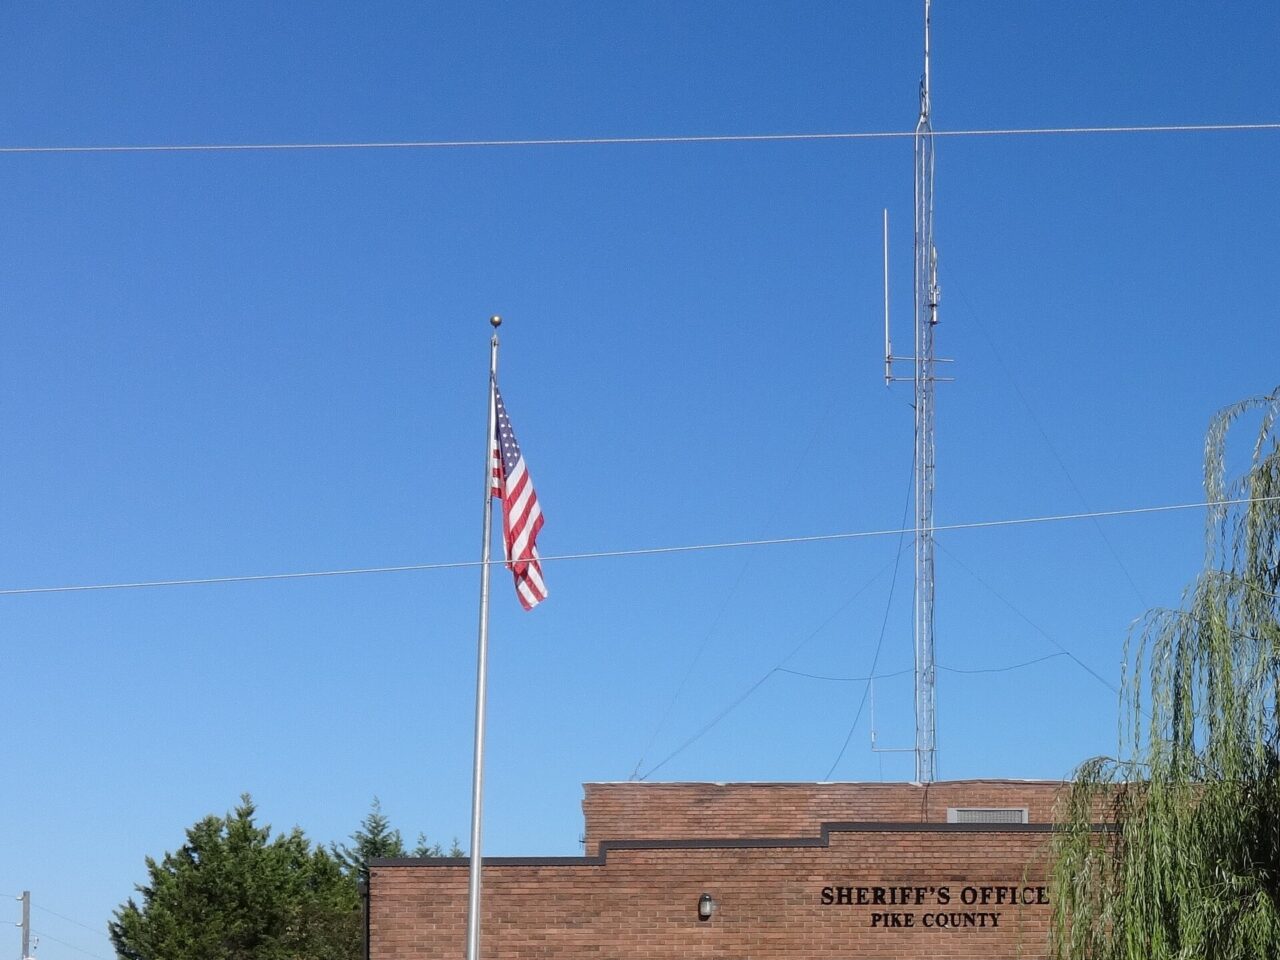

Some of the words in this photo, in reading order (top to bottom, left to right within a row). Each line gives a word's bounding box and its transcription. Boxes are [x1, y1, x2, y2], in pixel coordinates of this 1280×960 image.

[820, 886, 951, 905] SHERIFF'S
[960, 886, 1050, 905] OFFICE
[870, 912, 915, 928] PIKE
[922, 912, 1002, 928] COUNTY
